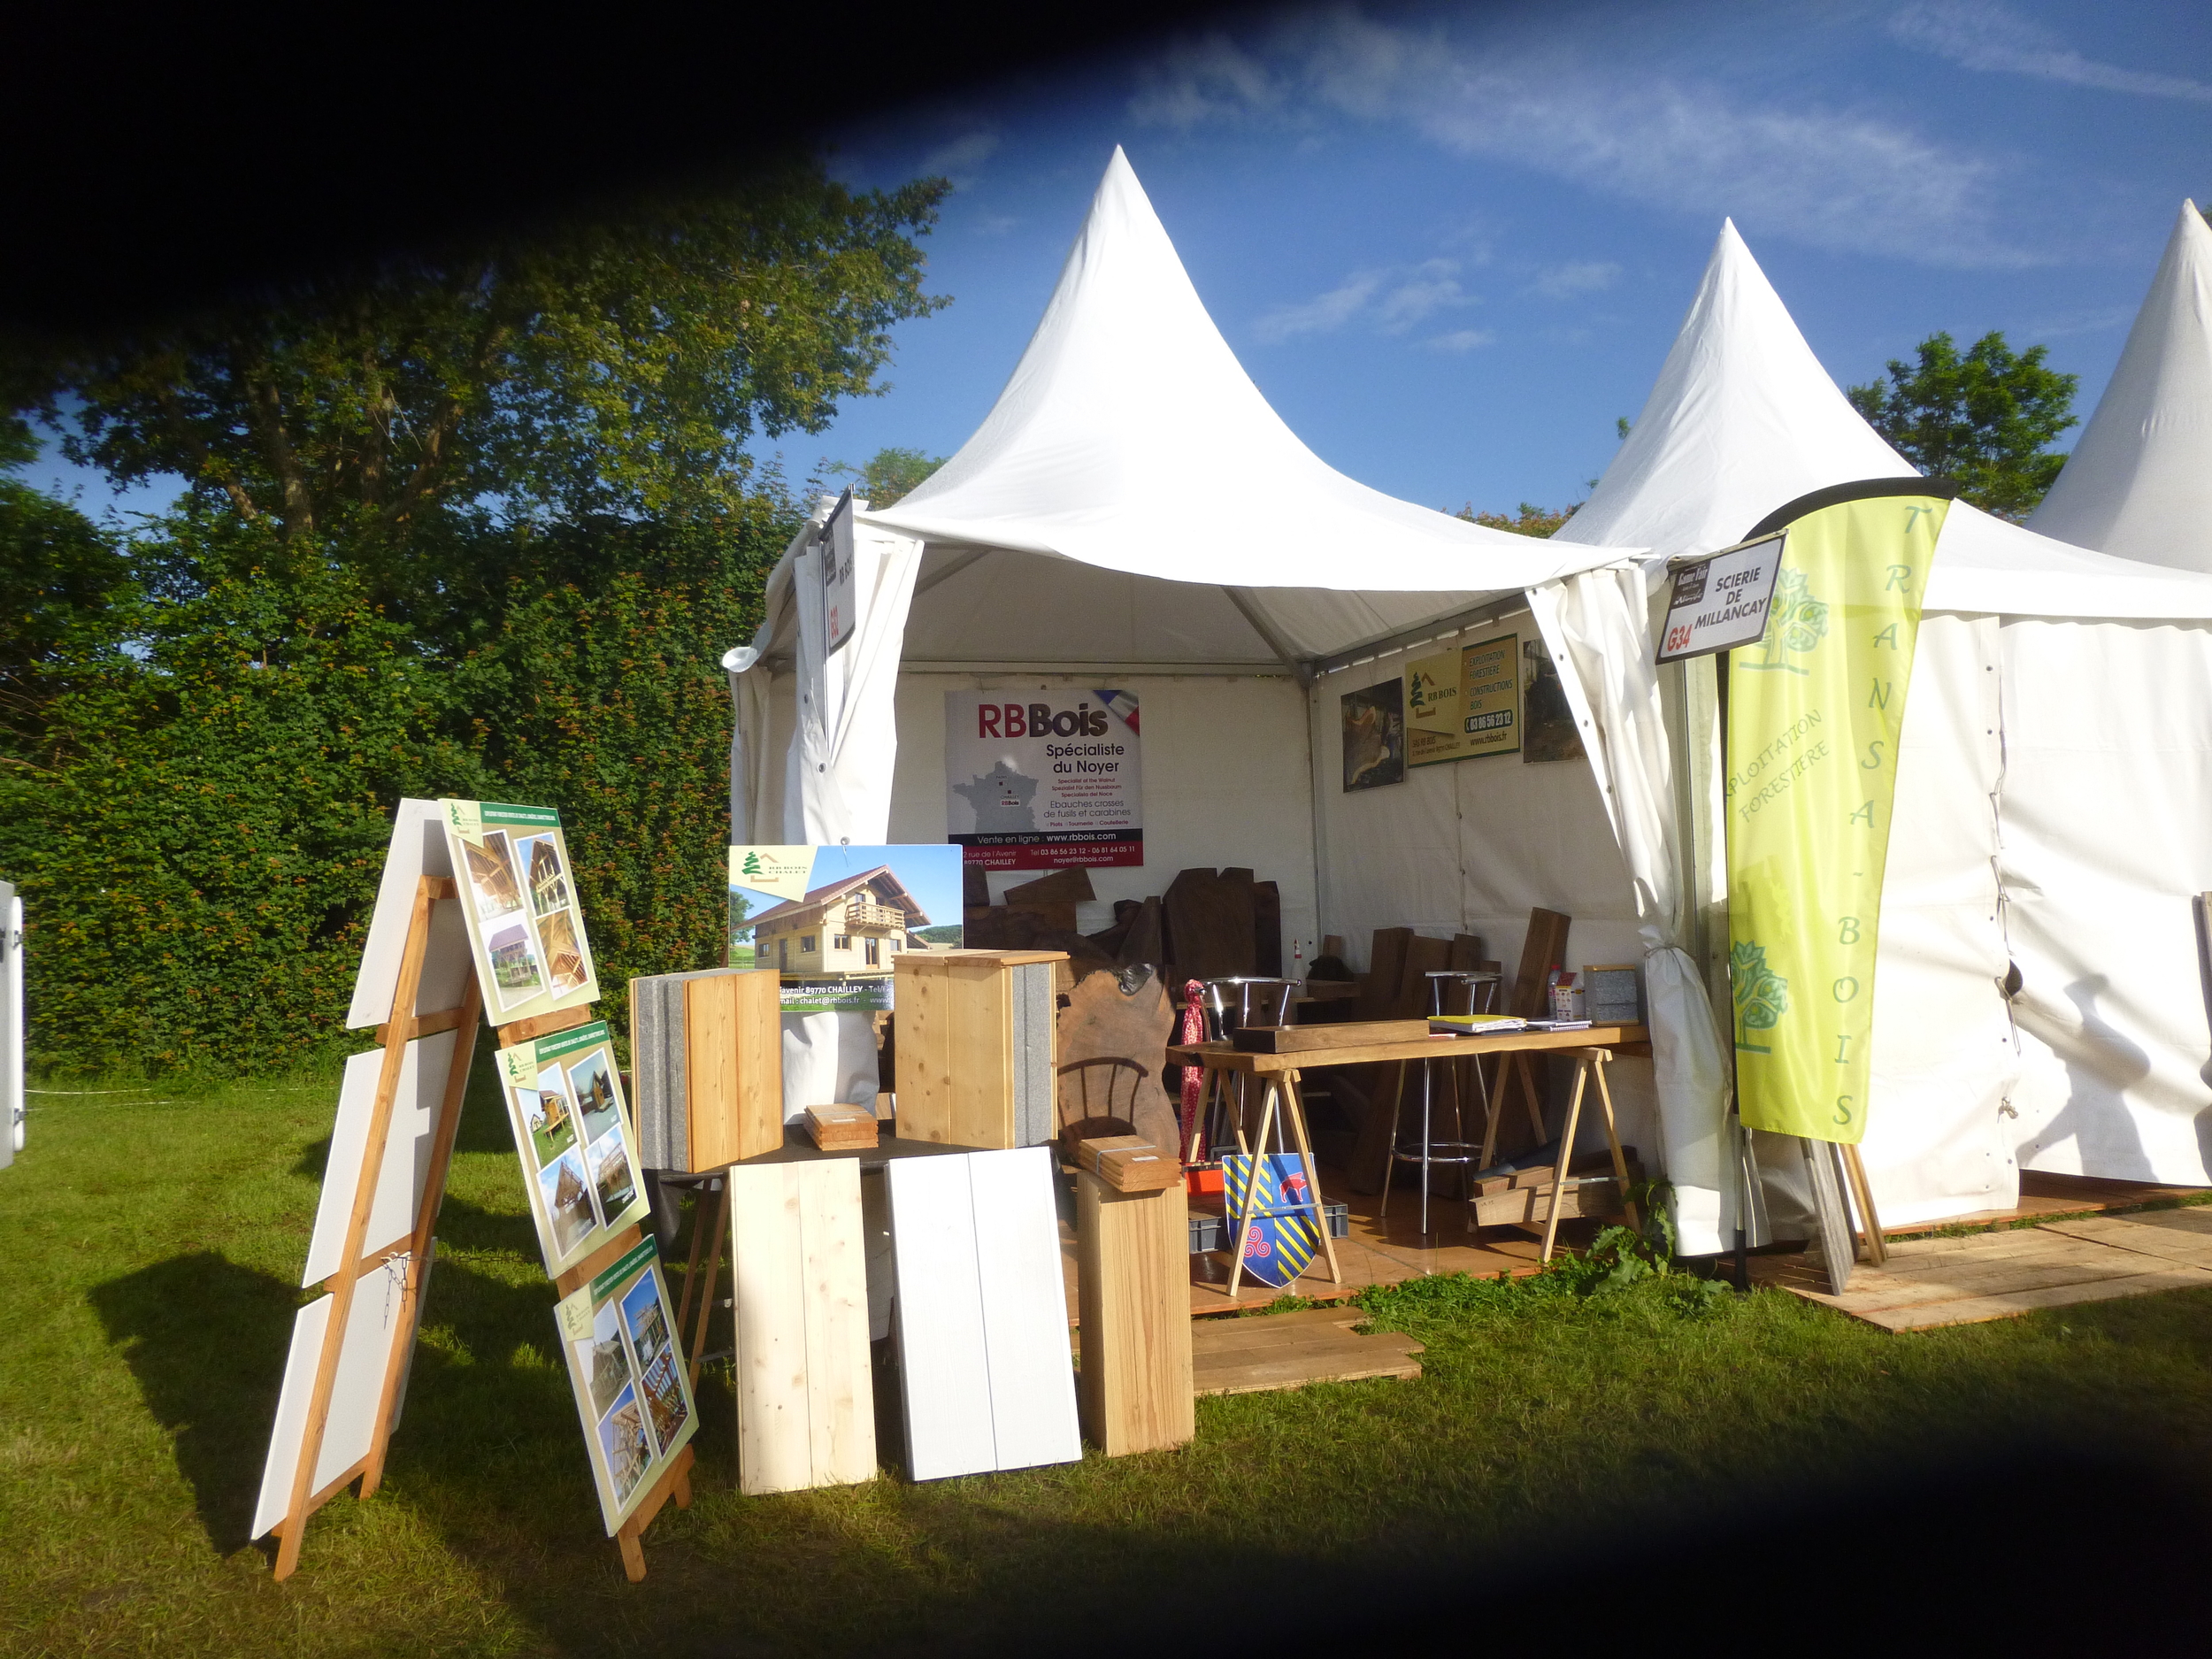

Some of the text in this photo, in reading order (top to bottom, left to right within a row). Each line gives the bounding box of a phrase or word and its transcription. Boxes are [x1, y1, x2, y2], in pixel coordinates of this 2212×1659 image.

[1715, 567, 1761, 592] SCIERIE
[1726, 588, 1743, 605] DE
[1694, 597, 1767, 630] MILLANCAY
[1667, 624, 1693, 652] G34
[1469, 649, 1505, 667] EXPLOITATION
[1469, 664, 1501, 680] FORESTIERE
[1428, 687, 1457, 702] RB BOIS
[1470, 679, 1513, 697] CONSTRUCTIONS
[1470, 699, 1482, 710] BOIS
[978, 703, 1109, 738] RBBois
[1470, 711, 1511, 730] 03 86 56 23 12
[1470, 731, 1508, 746] www.rbbois.fr
[1046, 743, 1125, 759] Spécialiste
[1053, 760, 1119, 775] du Noyer
[1739, 740, 1830, 824] FORESTIERE
[1050, 800, 1092, 809] Ebauches
[1044, 810, 1056, 818] de
[1089, 808, 1131, 817] carabines
[977, 836, 1003, 844] Vente
[1018, 835, 1040, 845] ligne
[1046, 833, 1117, 842] www.rbbois.com
[1053, 855, 1114, 864] noyer@rbbois.com
[806, 986, 826, 995] 89770
[827, 985, 864, 994] CHAILLEY
[800, 996, 860, 1006] chalet@rbbois.fr
